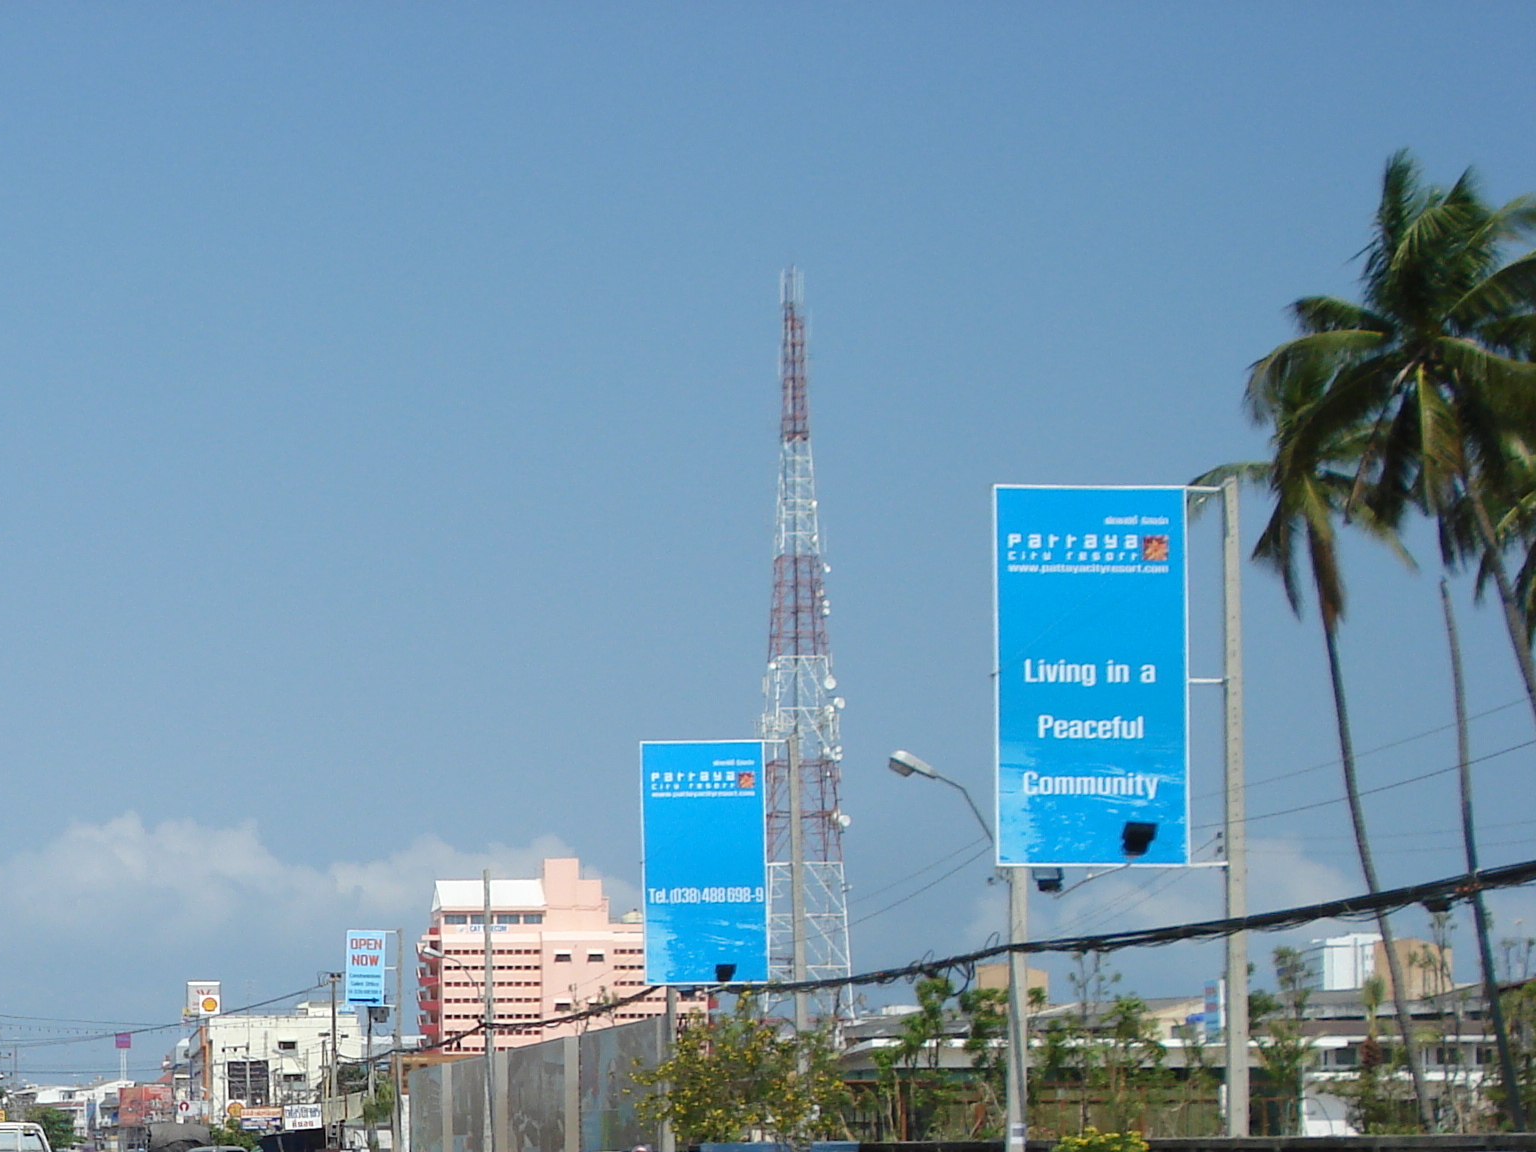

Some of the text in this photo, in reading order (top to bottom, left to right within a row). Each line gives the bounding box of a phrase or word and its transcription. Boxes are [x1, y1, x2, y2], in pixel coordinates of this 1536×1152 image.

[1024, 658, 1156, 688] Living in a
[1037, 713, 1144, 740] Peaceful
[1022, 769, 1159, 801] Community
[648, 886, 764, 904] Tel. (038) 488 698-9
[350, 938, 383, 950] OPEN
[351, 954, 379, 966] NOW
